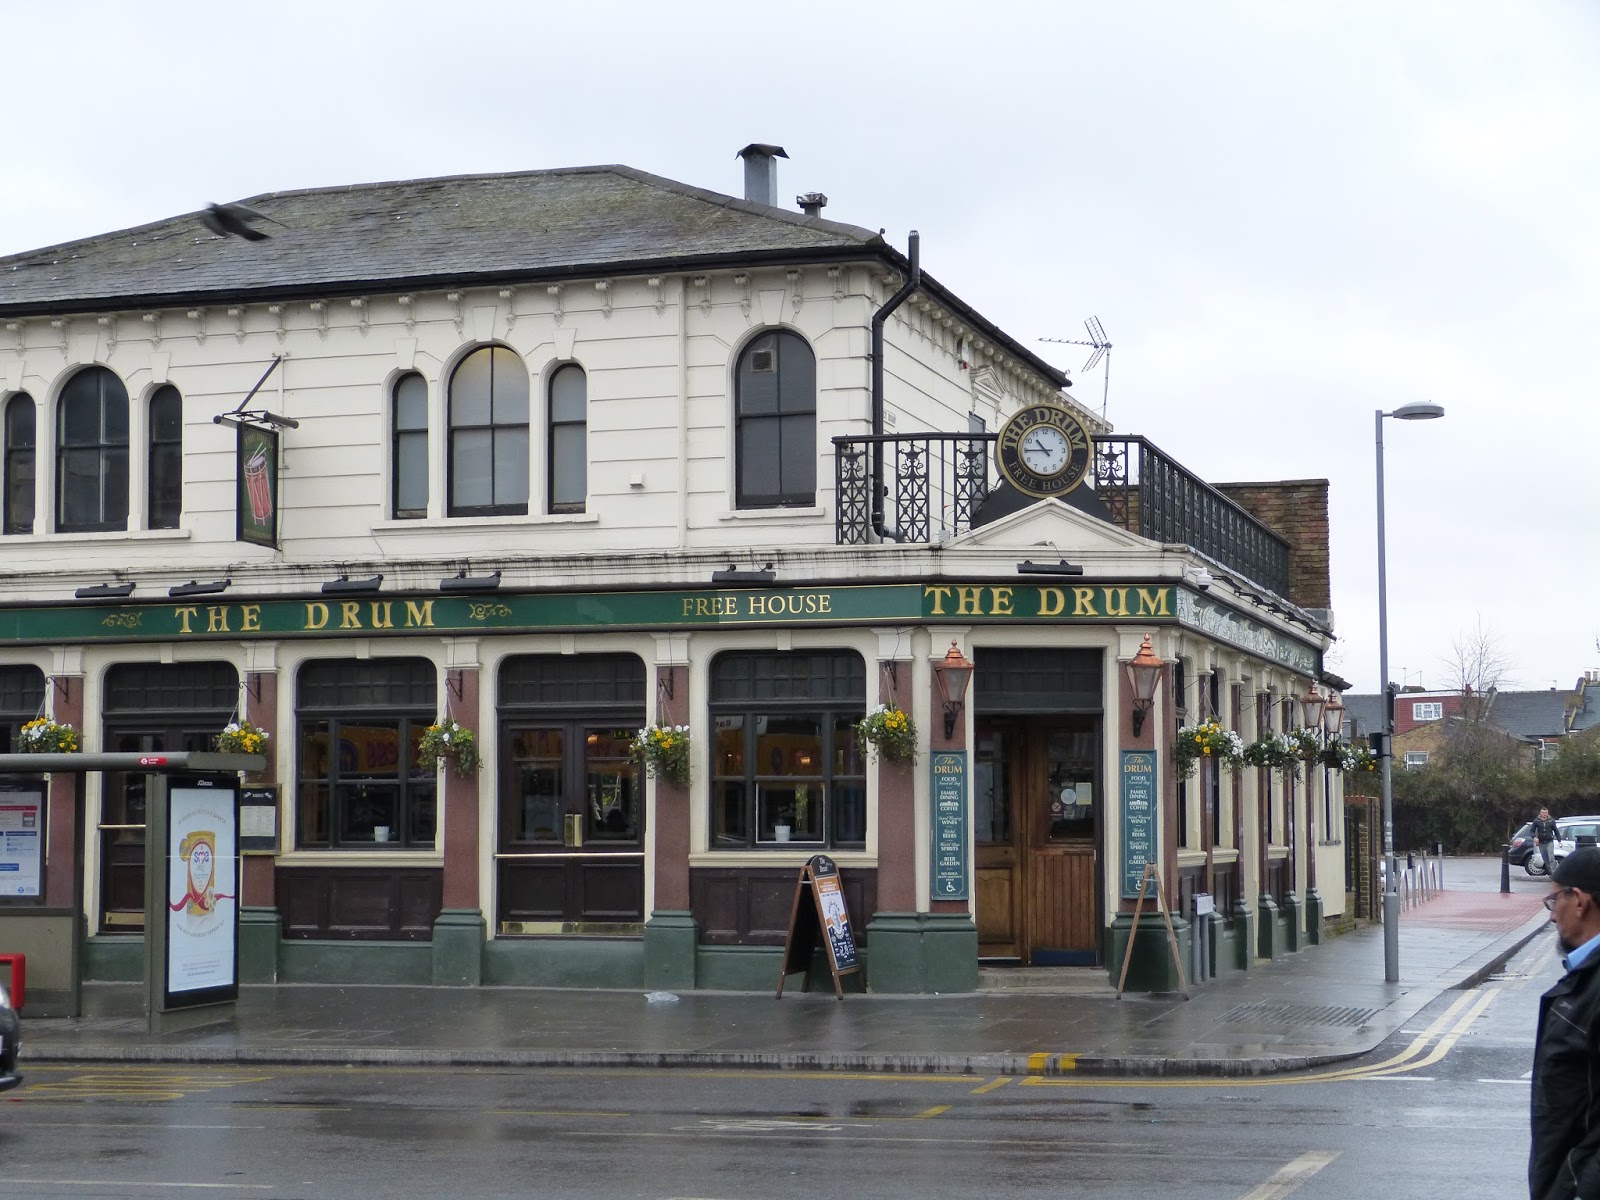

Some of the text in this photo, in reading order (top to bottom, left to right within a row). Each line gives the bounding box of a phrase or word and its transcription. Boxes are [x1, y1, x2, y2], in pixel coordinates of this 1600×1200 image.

[1002, 408, 1087, 450] THE DRUM
[1009, 462, 1082, 490] FREE HOUSE
[682, 594, 832, 616] FREE HOUSE
[924, 586, 1171, 616] THE DRUM
[174, 600, 435, 633] THE DRUM
[934, 766, 962, 774] DRUM
[941, 756, 954, 764] The
